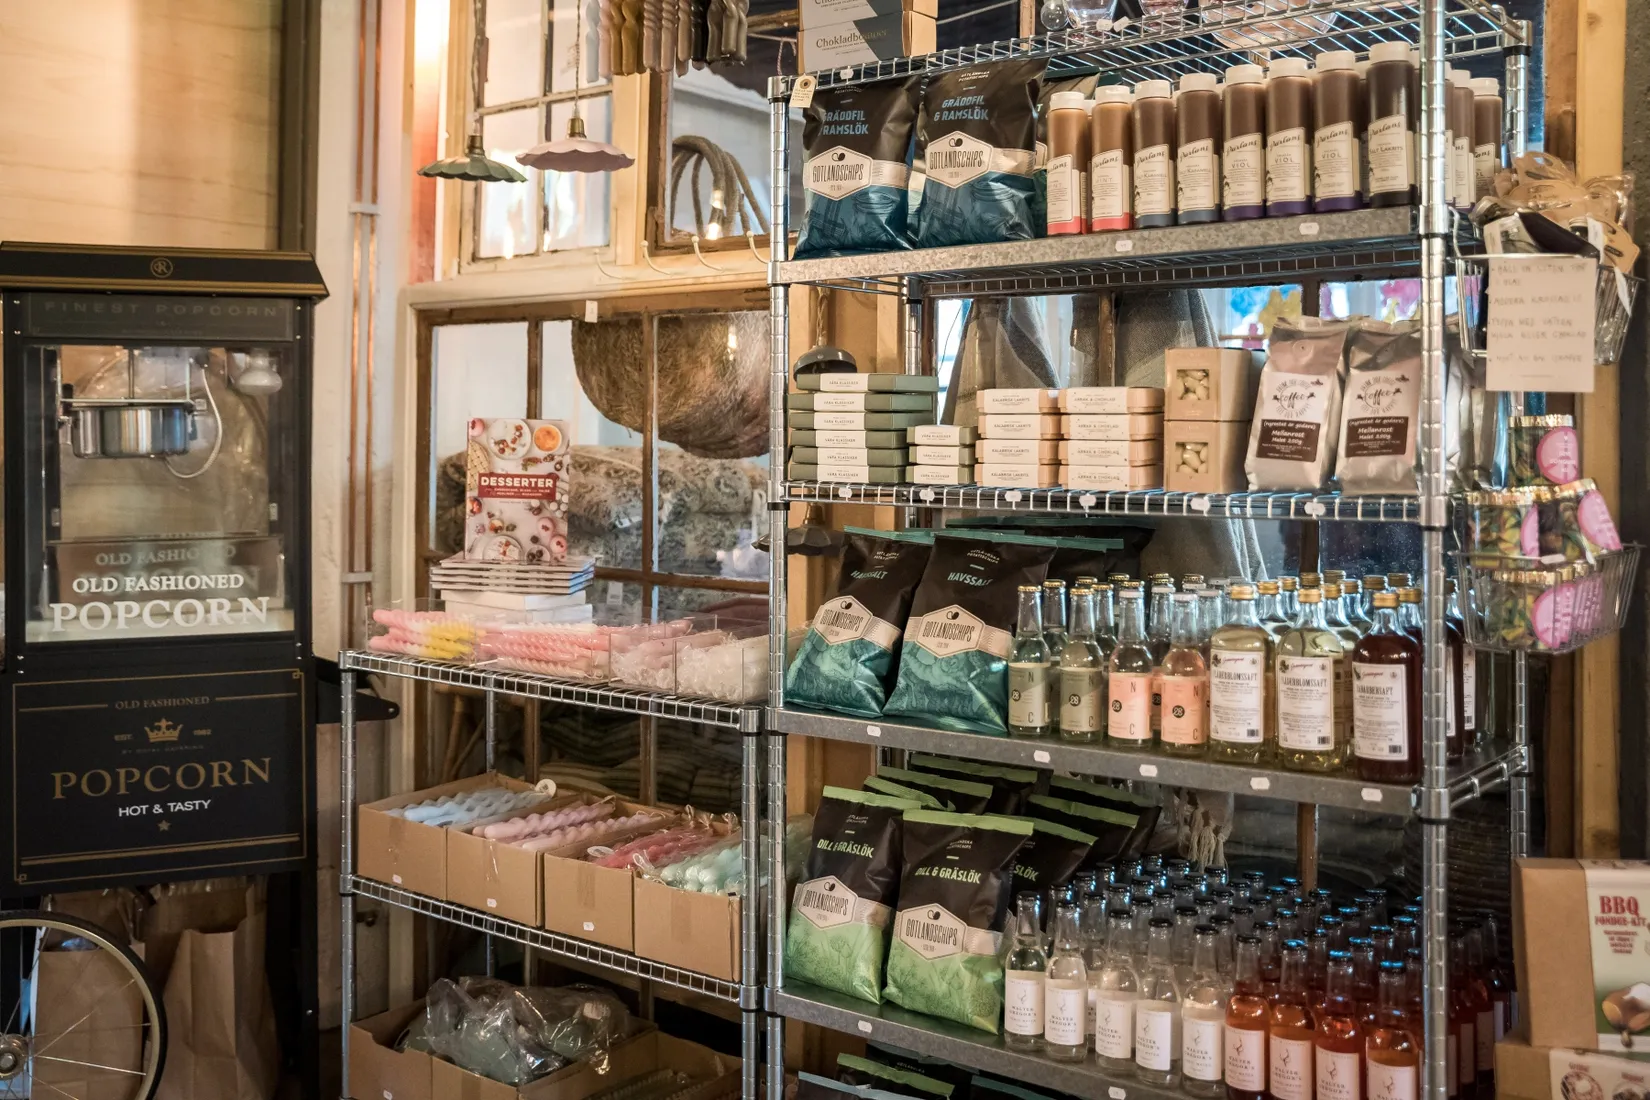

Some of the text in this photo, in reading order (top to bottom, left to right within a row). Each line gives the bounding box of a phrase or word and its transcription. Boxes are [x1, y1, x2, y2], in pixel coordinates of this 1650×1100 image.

[941, 95, 985, 108] GRÄDDFIL
[941, 106, 989, 121] RAMSLÖK
[823, 122, 869, 135] RAMSLÖK
[929, 150, 984, 170] GOTLANDSCHIPS
[812, 163, 864, 183] GOTLANDSCHIPS
[45, 302, 277, 316] FINEST POPCORN
[481, 476, 554, 488] DESSERTER
[72, 573, 244, 594] OLD FASHIONED
[947, 572, 994, 587] HAVSSALT
[49, 596, 270, 632] POPCORN
[820, 608, 864, 632] GOTLANDSCHIPS
[922, 621, 975, 642] GOTLANDSCHIPS
[143, 696, 210, 708] FASHIONED
[50, 757, 272, 800] POPCORN
[118, 799, 212, 817] HOT & TASTY
[817, 838, 834, 851] DILL
[837, 841, 874, 859] GRÄSLÖK
[939, 867, 982, 884] GRÄSLÖK
[1013, 864, 1040, 882] SLÖK
[803, 889, 849, 916] GOTLANDSCHIPS
[1599, 895, 1640, 917] BBQ
[905, 918, 958, 946] GOTLANDSCHIPS
